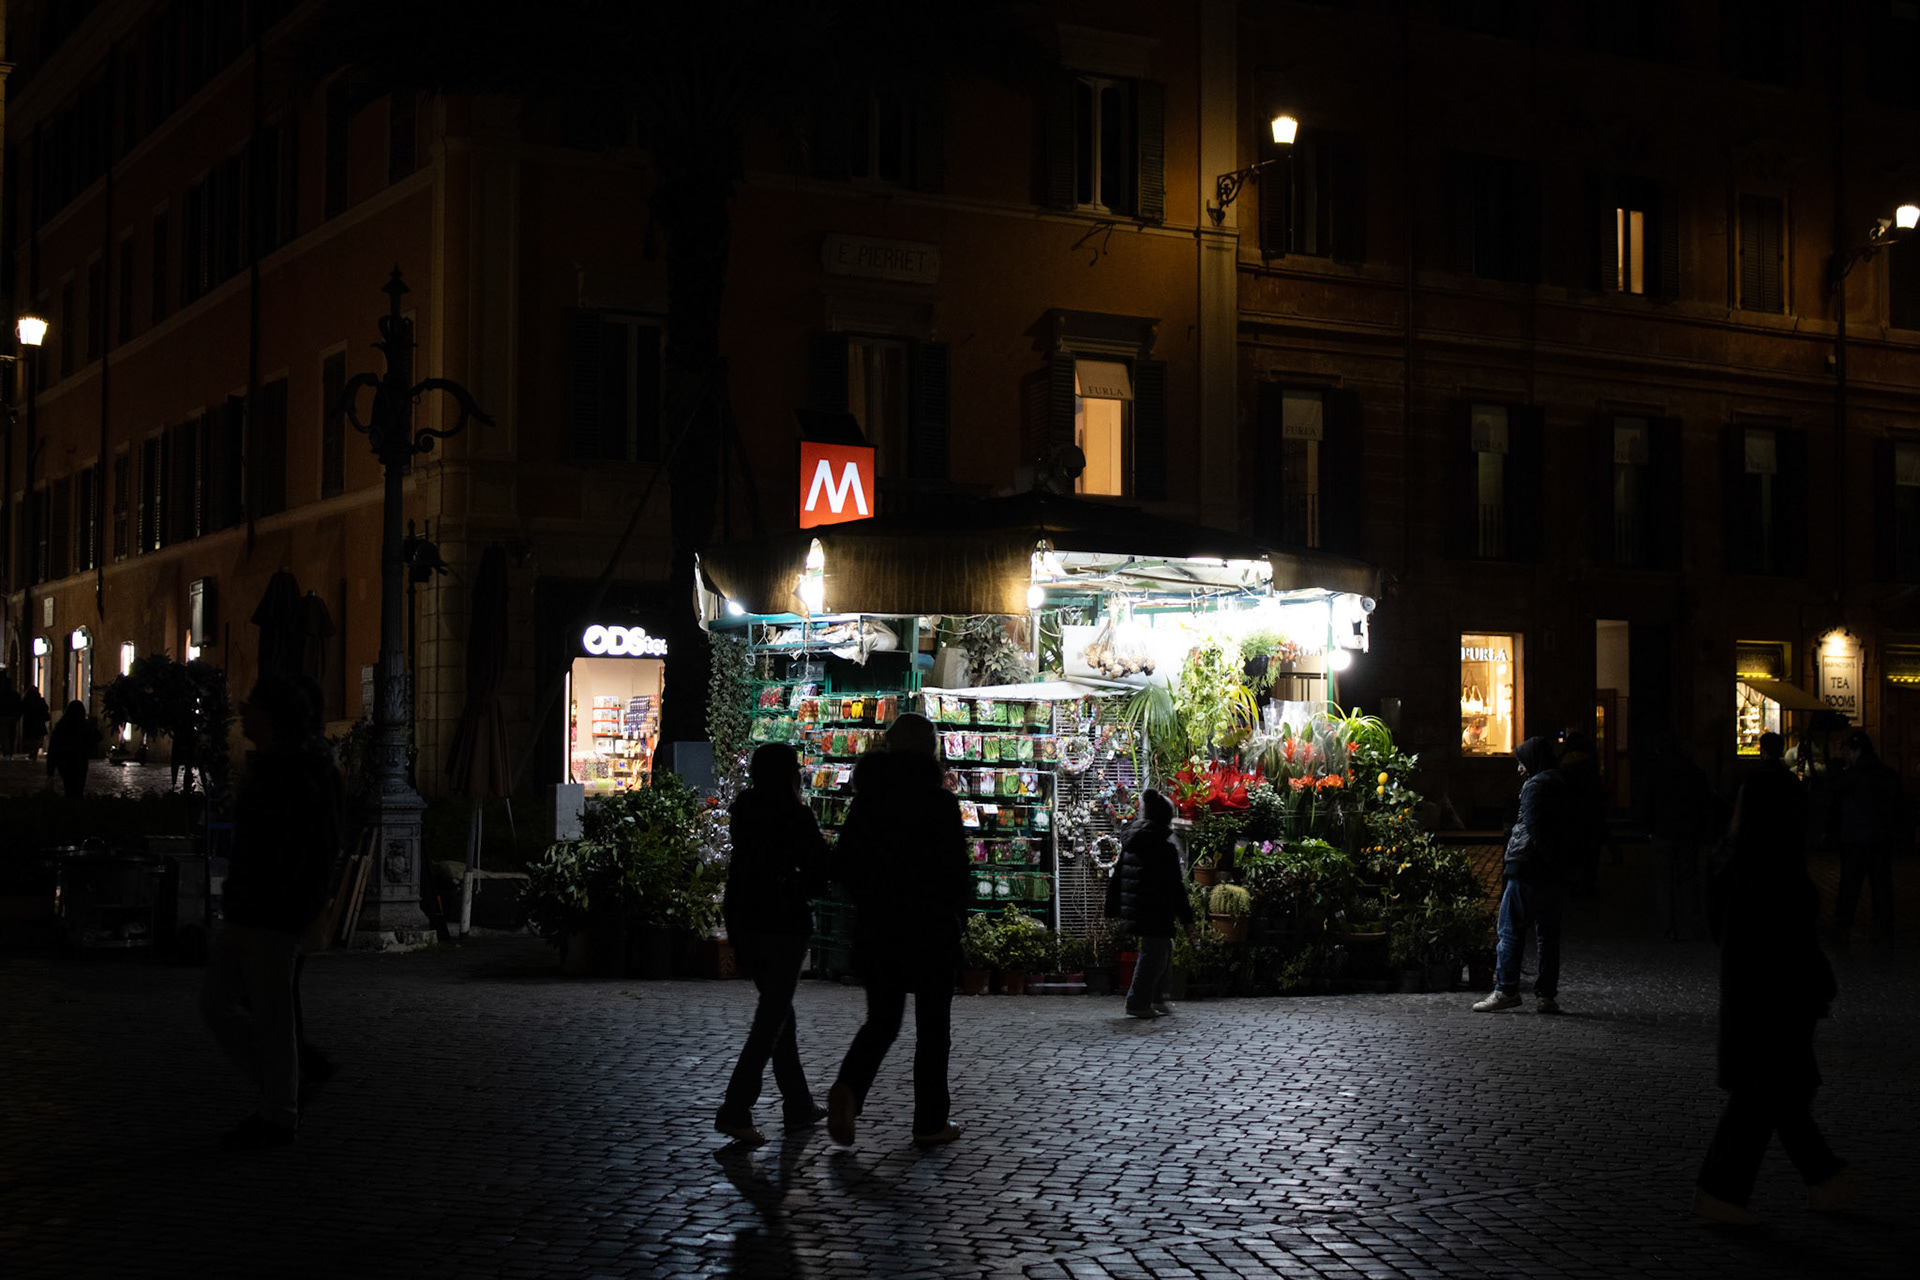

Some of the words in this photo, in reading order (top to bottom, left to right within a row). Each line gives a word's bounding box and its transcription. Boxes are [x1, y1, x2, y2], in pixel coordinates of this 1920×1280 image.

[859, 246, 928, 272] PIERRET
[1089, 386, 1123, 396] FURLA
[1286, 425, 1317, 437] FURLA
[804, 459, 869, 515] M
[1461, 647, 1508, 661] FURLA
[1831, 677, 1850, 689] TEA
[1825, 694, 1855, 708] ROOMS
